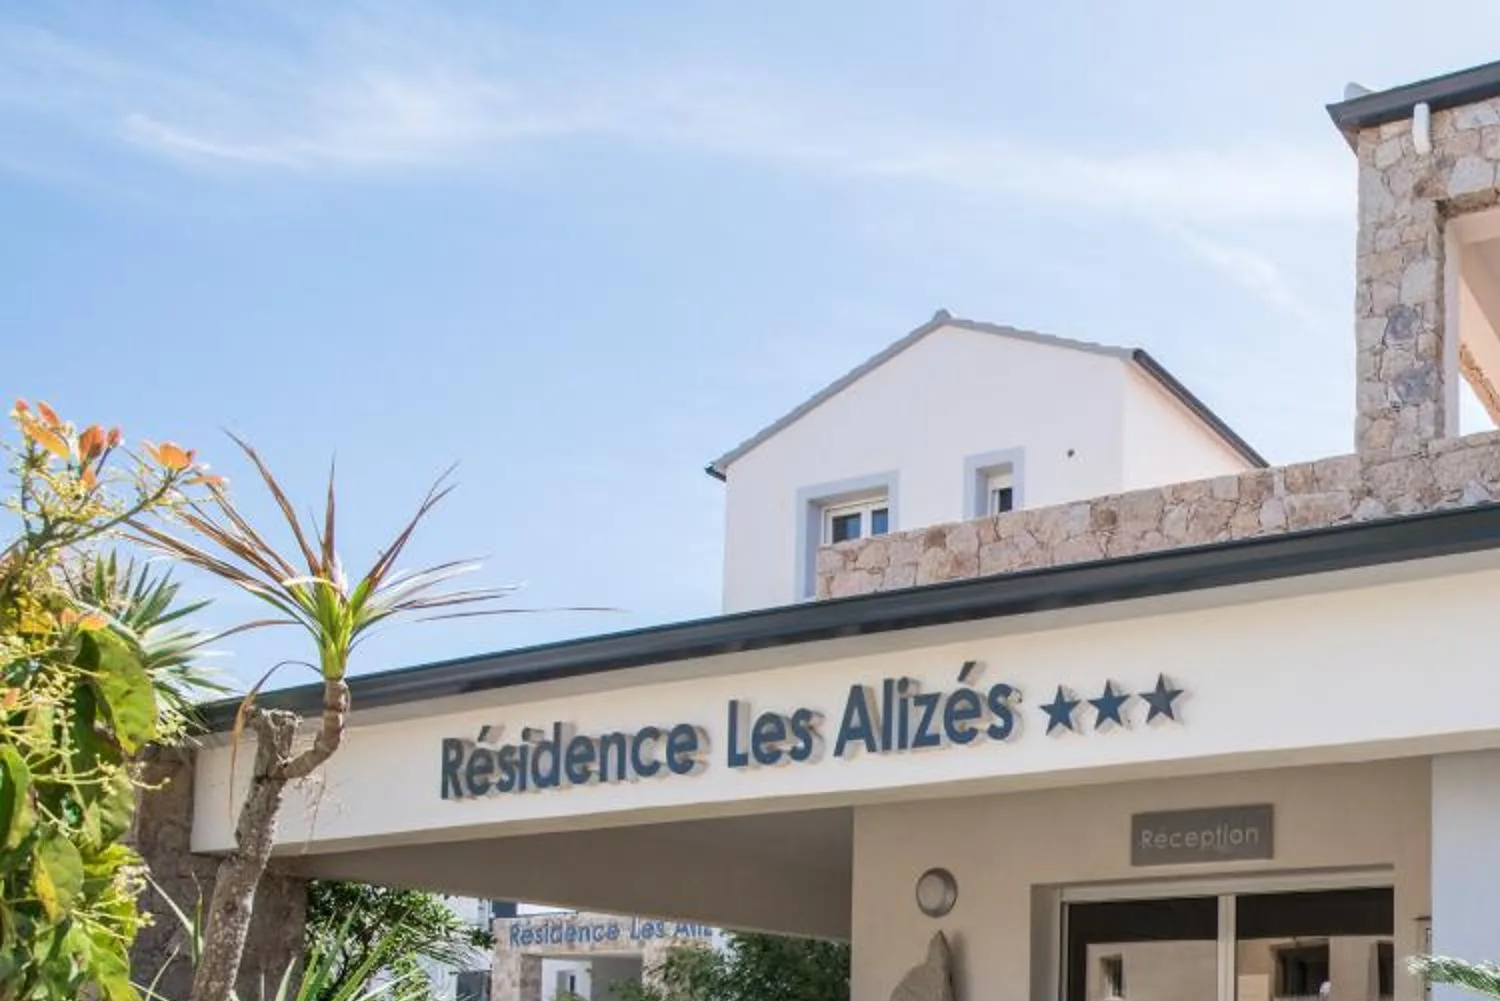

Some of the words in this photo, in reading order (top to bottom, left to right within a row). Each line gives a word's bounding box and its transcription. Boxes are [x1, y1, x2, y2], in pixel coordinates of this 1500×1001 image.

[442, 720, 706, 800] Résidence
[727, 699, 817, 769] Les
[833, 661, 1022, 757] Alizés
[509, 916, 621, 947] Résidence
